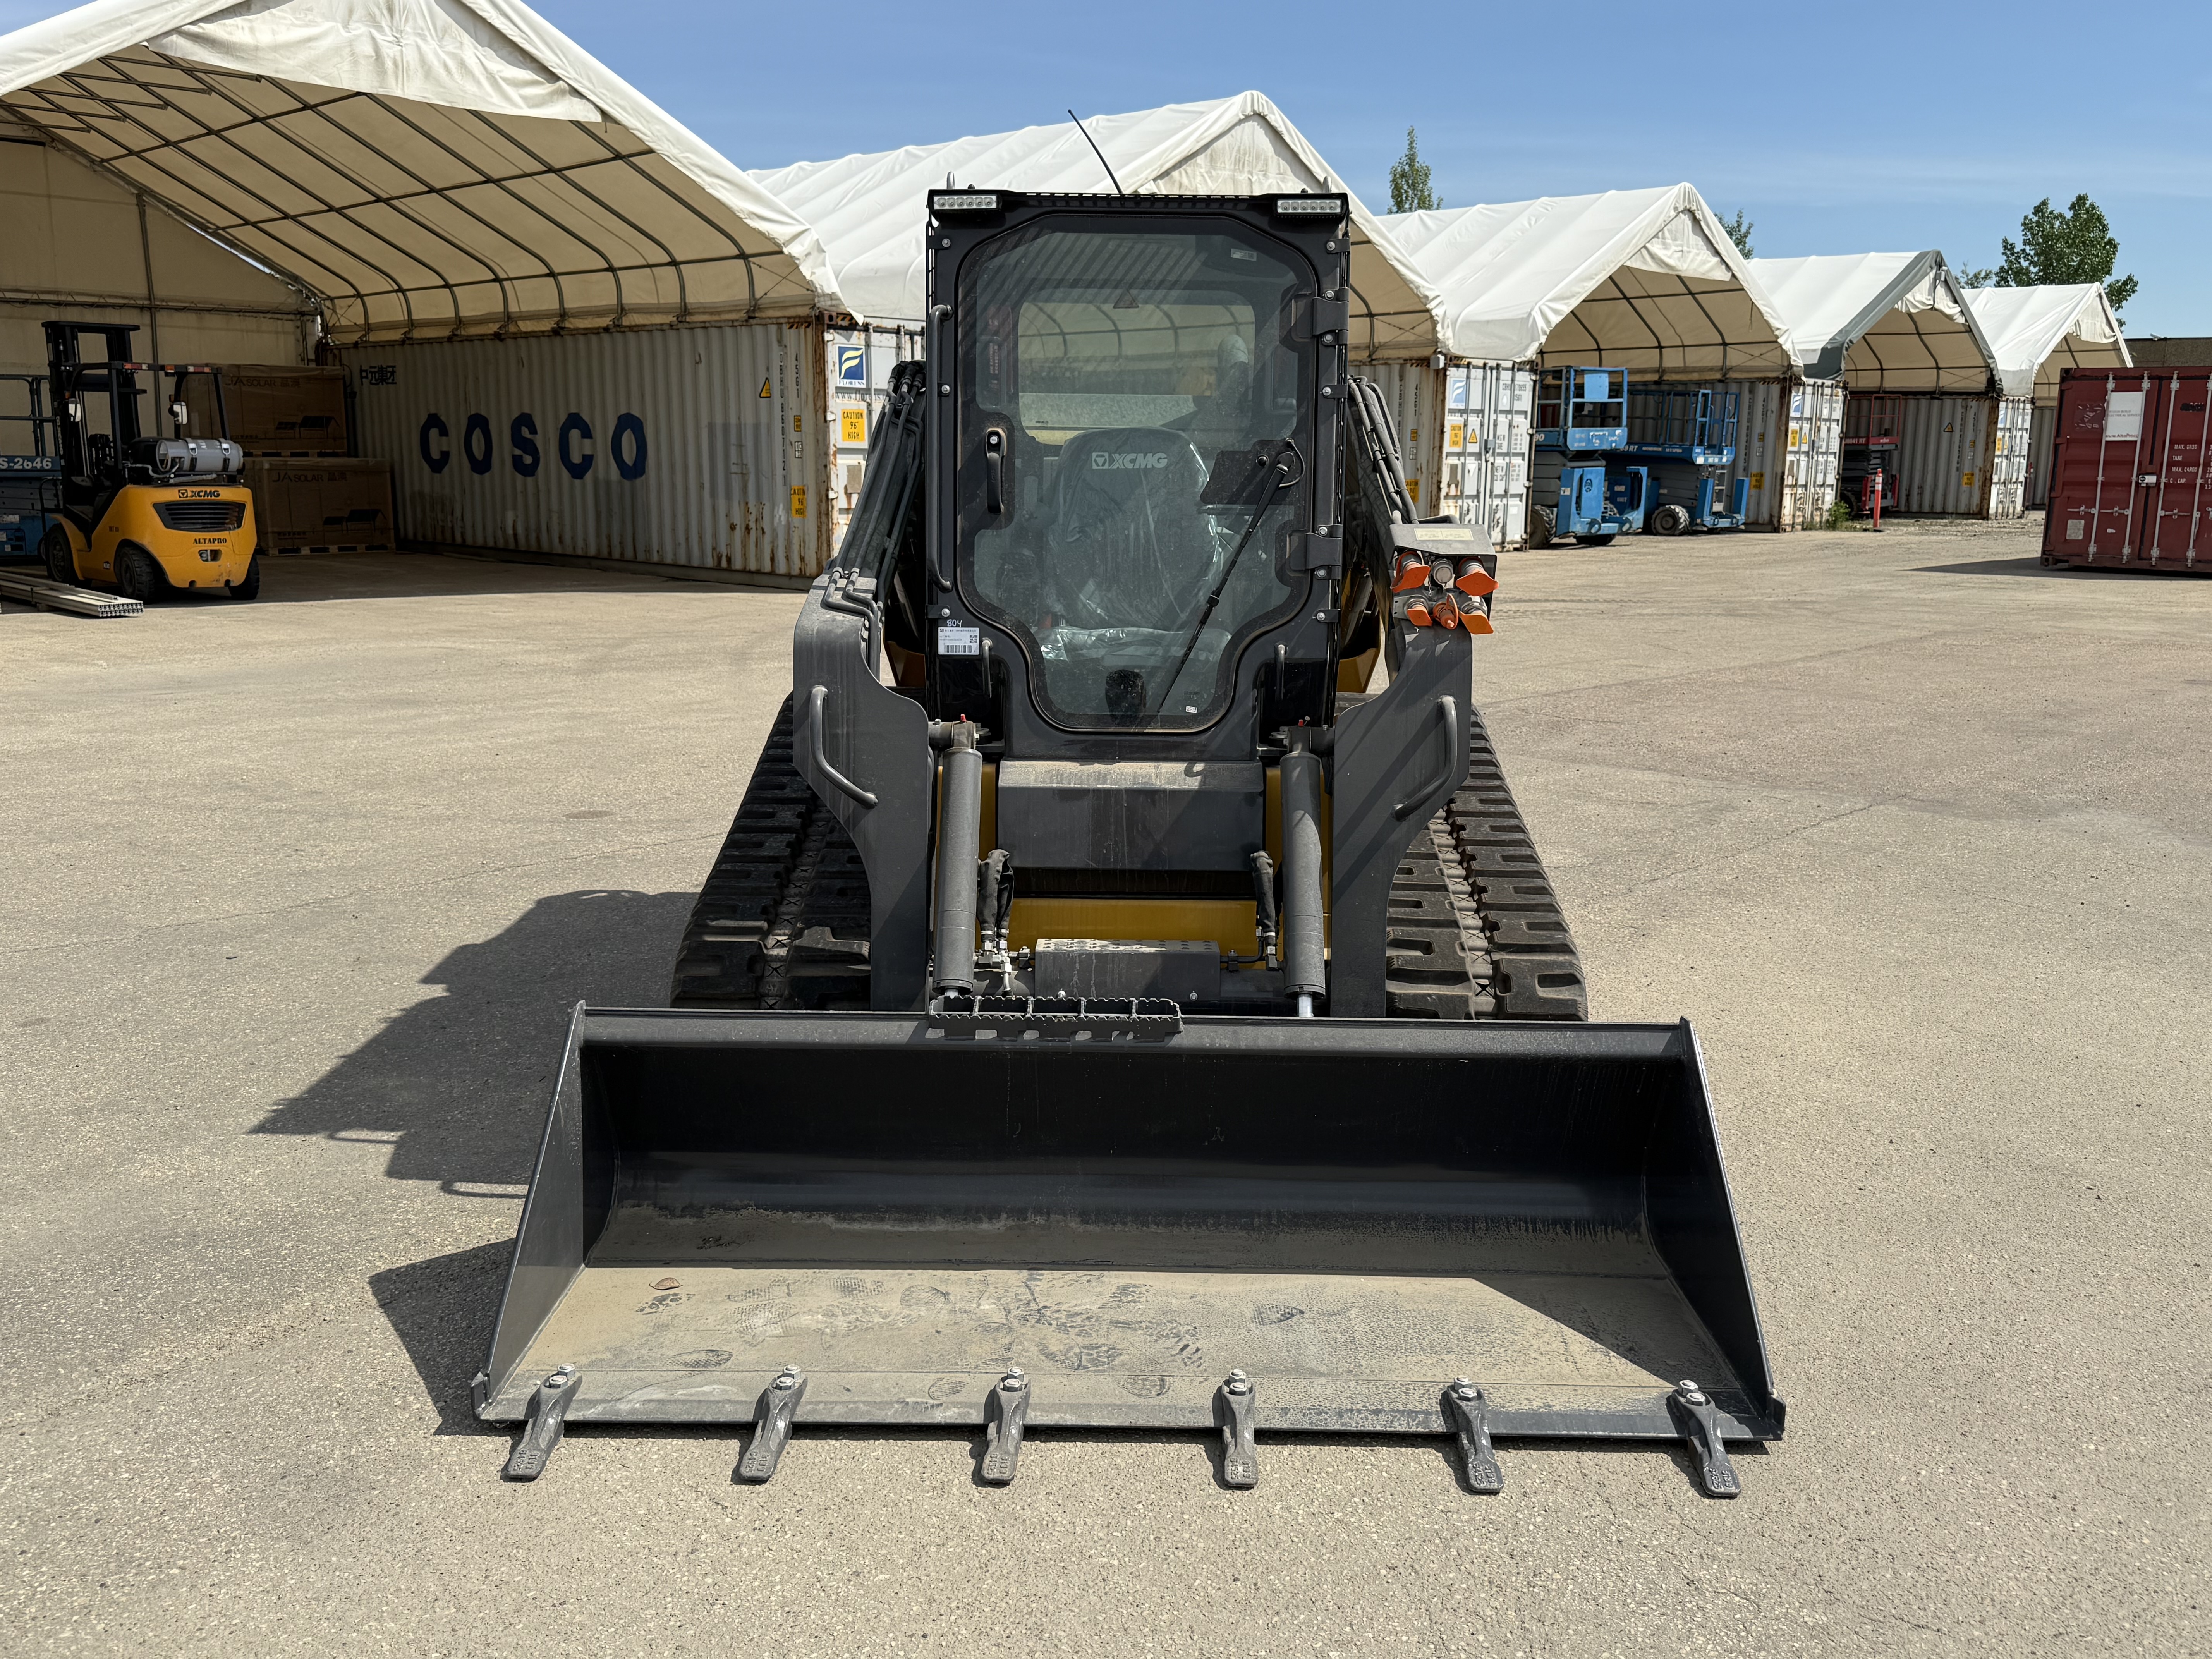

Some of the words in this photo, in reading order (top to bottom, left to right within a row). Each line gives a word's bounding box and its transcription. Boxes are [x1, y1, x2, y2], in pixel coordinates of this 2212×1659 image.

[420, 412, 647, 481] COSCO
[1109, 452, 1168, 469] XCMG
[273, 472, 293, 482] JA
[294, 474, 323, 482] SOLAR
[189, 490, 220, 498] XCMG
[947, 619, 963, 627] 804
